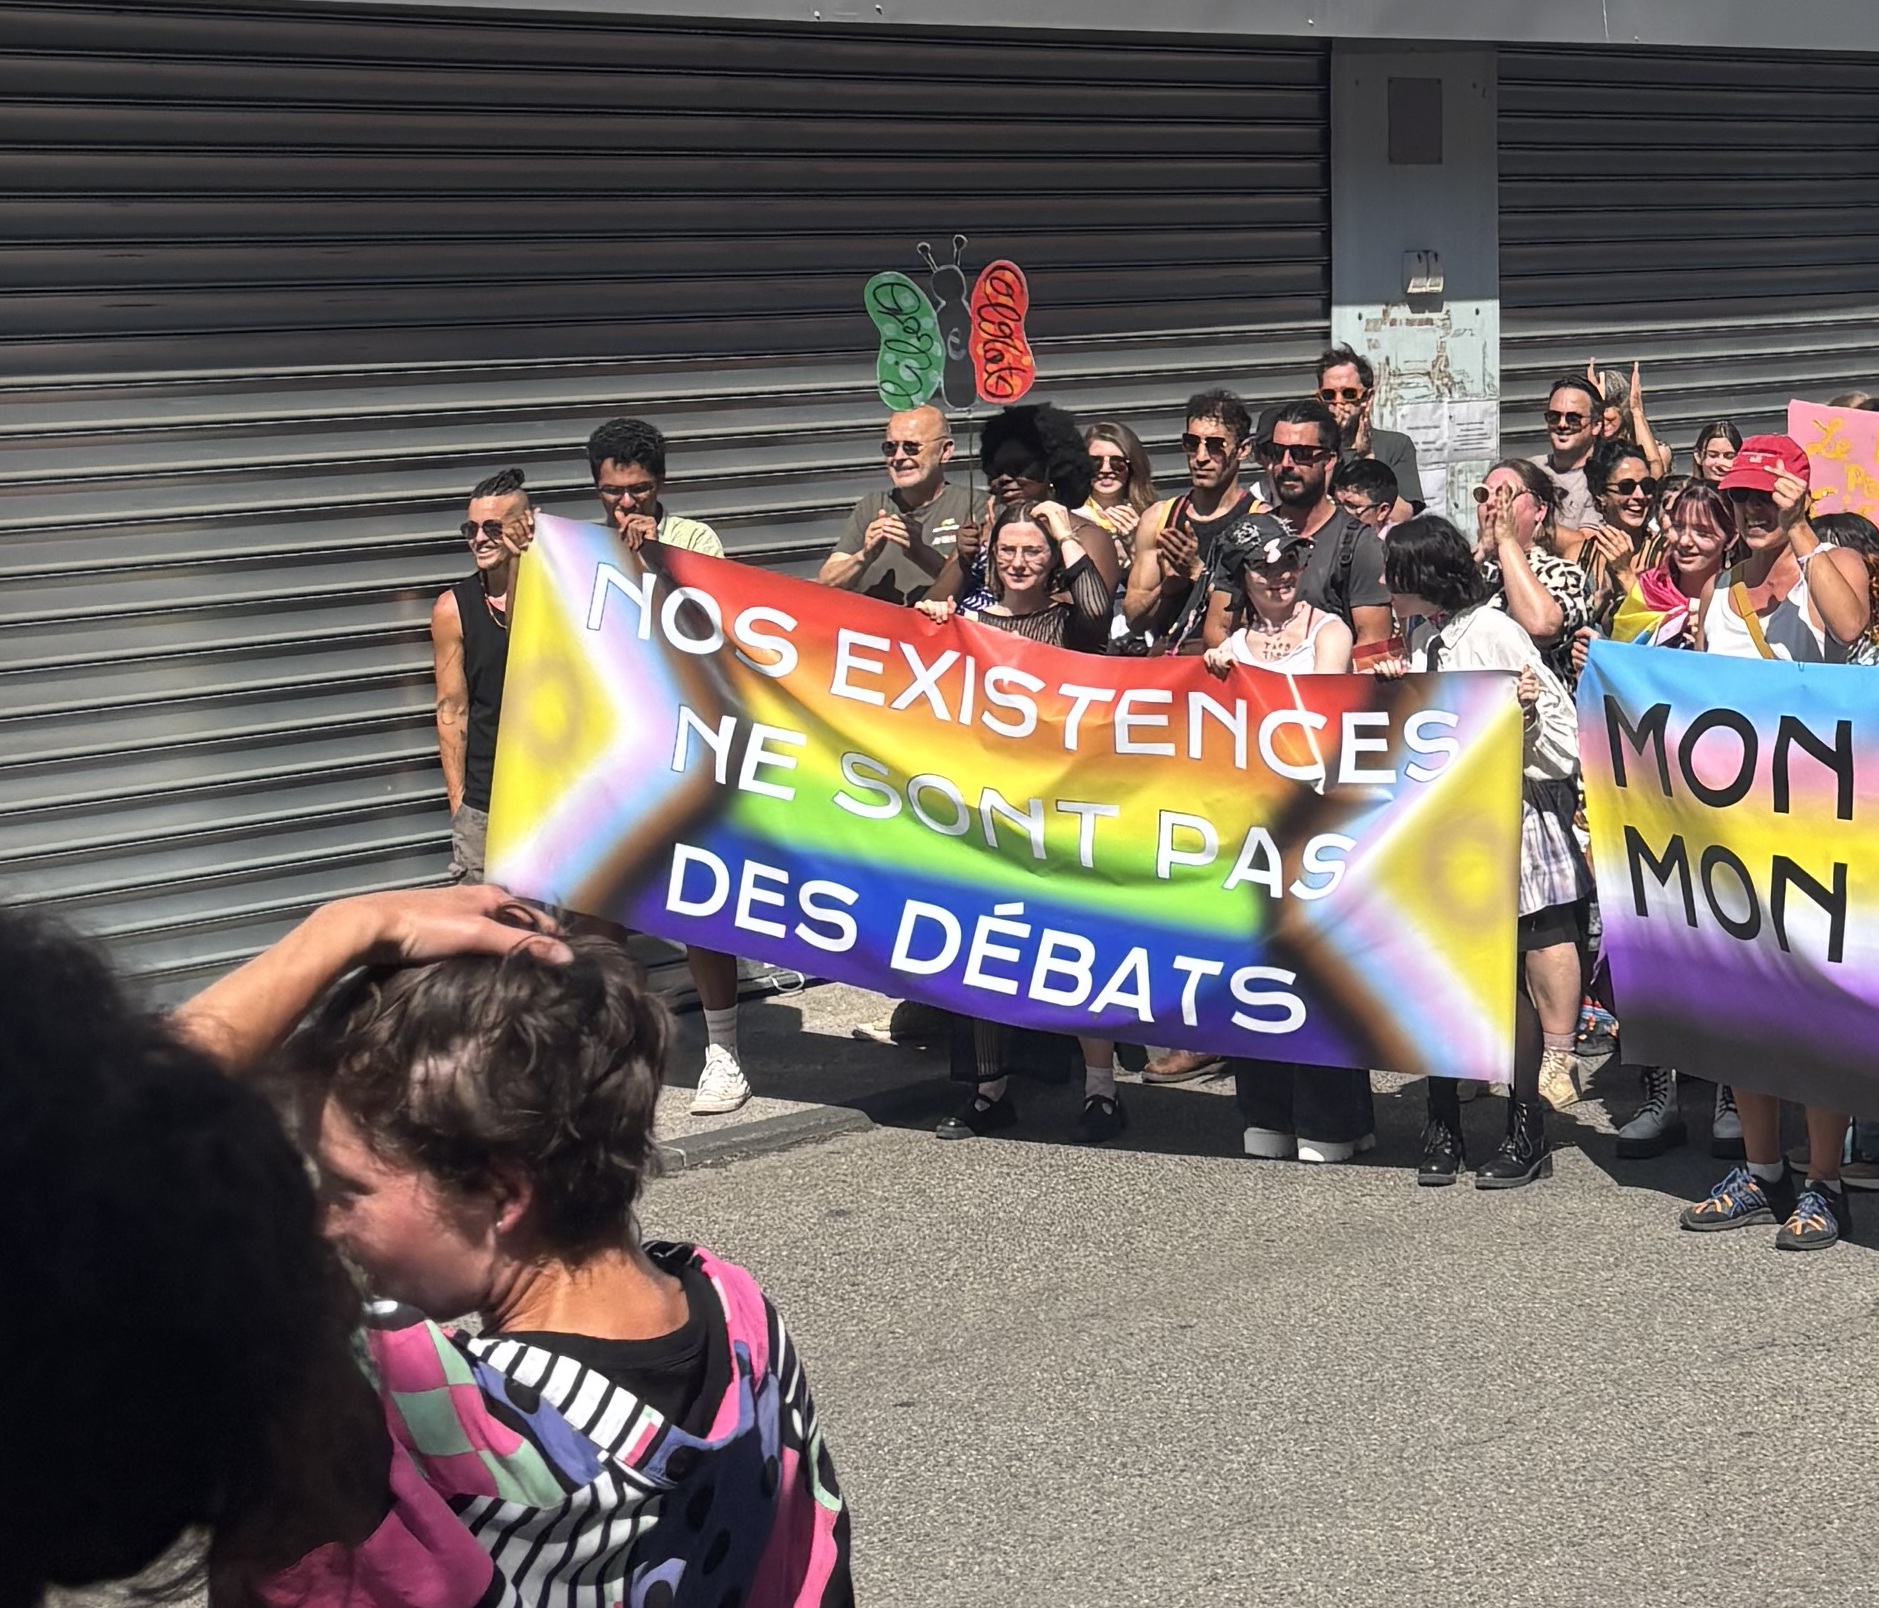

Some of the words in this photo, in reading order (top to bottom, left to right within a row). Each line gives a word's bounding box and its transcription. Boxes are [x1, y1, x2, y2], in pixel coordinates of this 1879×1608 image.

[1806, 417, 1852, 461] Le
[587, 562, 798, 678] NOS
[830, 628, 1460, 785] EXISTENCES
[672, 704, 807, 801] NE
[833, 751, 1119, 868] SONT
[1157, 809, 1358, 901] PAS
[1603, 694, 1853, 820] MON
[666, 842, 859, 952] DES
[890, 899, 1307, 1034] DÉBATS
[1624, 825, 1848, 964] MON
